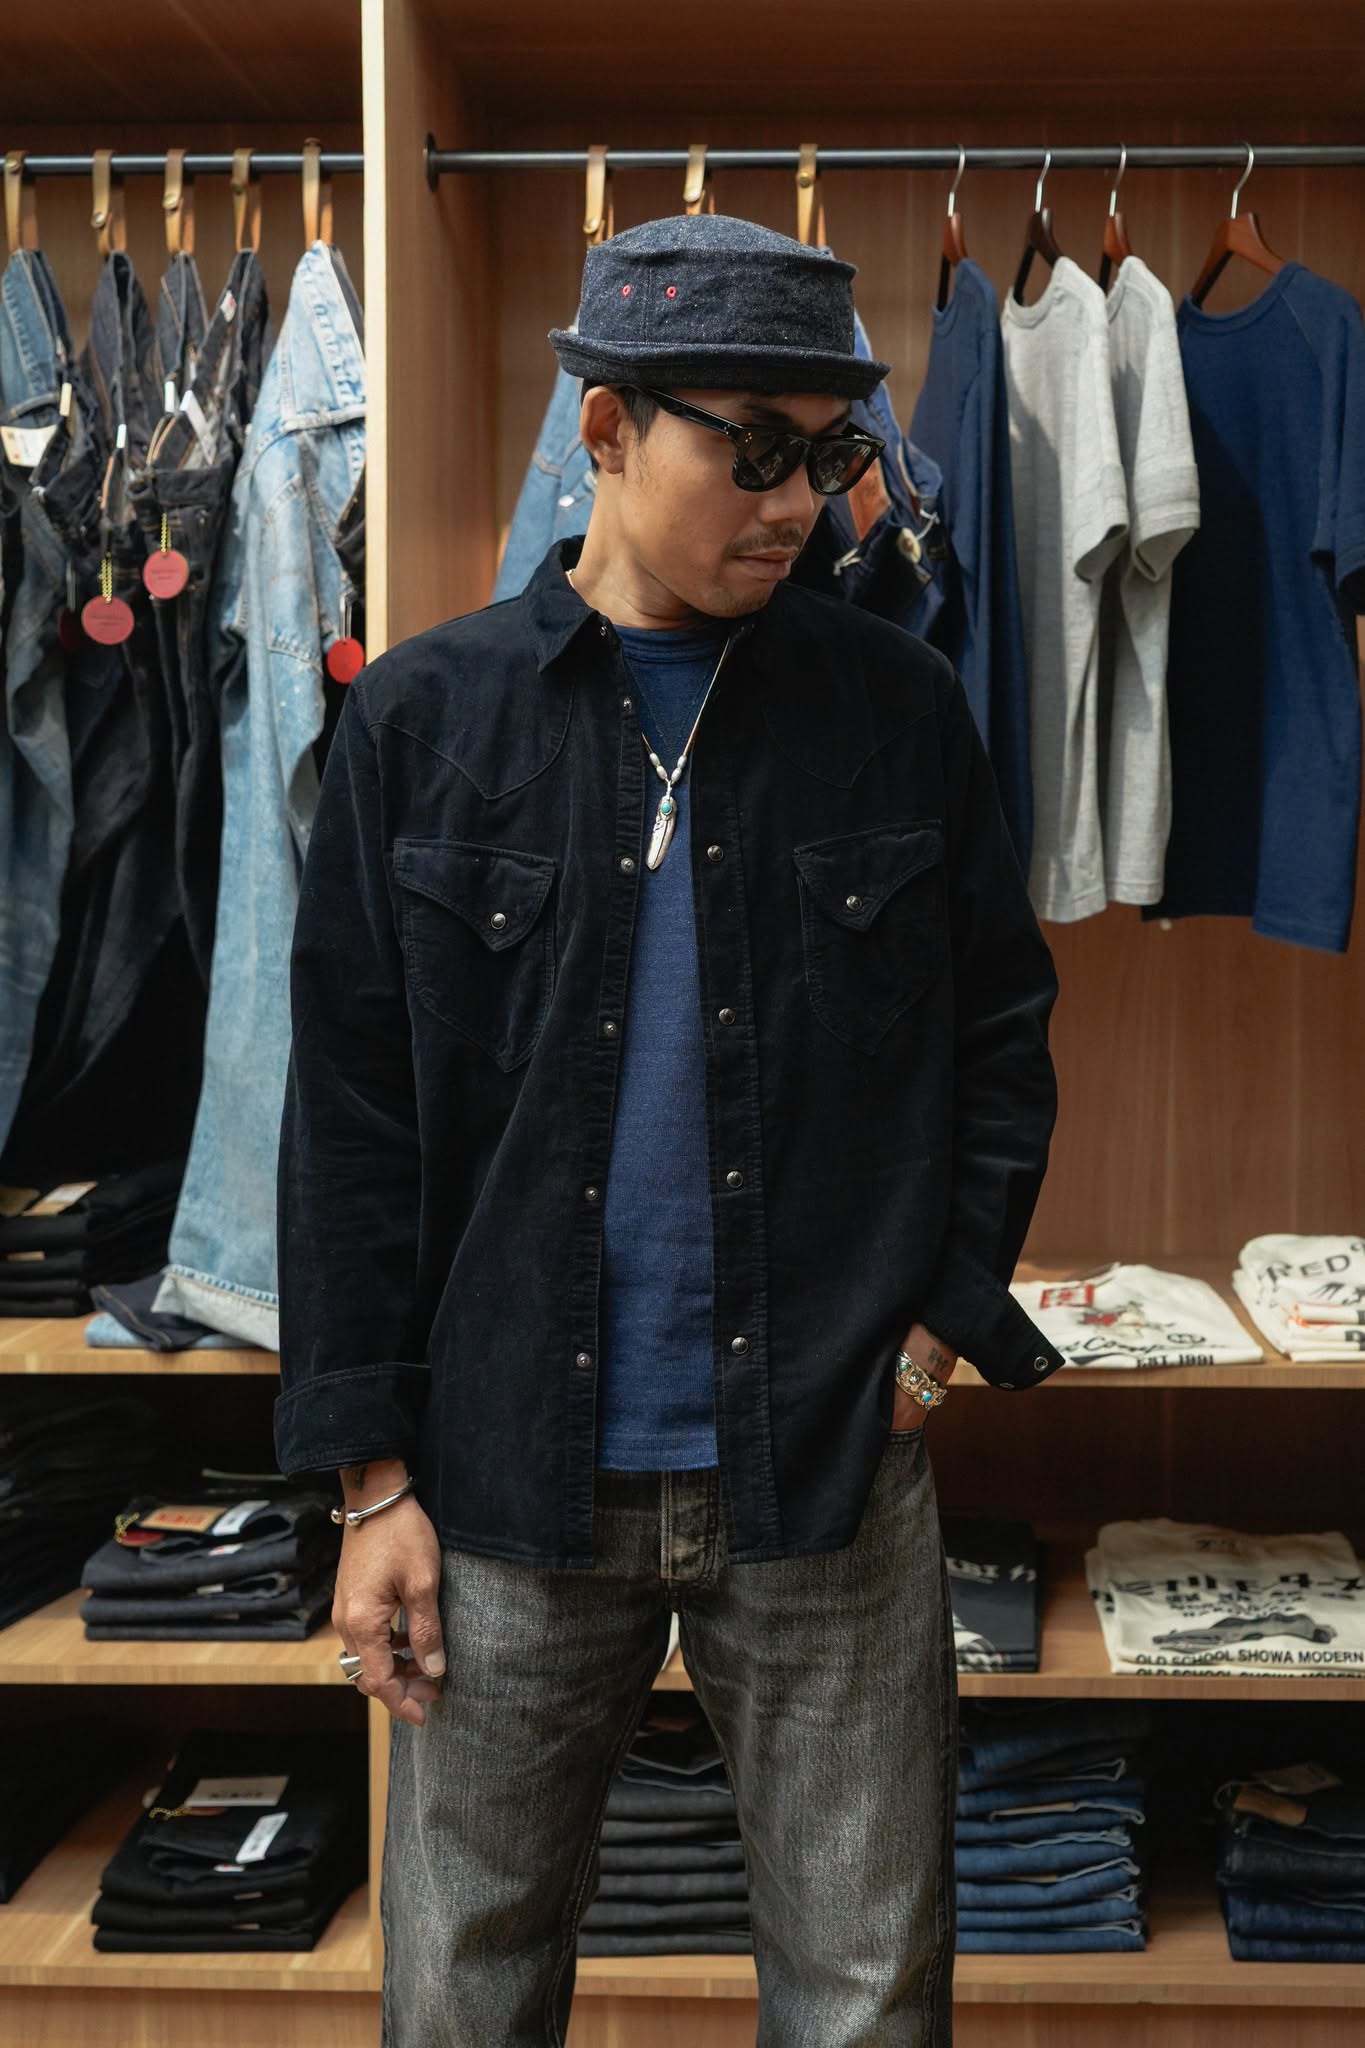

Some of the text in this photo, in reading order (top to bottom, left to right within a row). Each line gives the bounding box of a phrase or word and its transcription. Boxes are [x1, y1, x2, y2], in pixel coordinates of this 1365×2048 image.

[1135, 1649, 1365, 1666] OLD SCHOOL SHOWA MODERN
